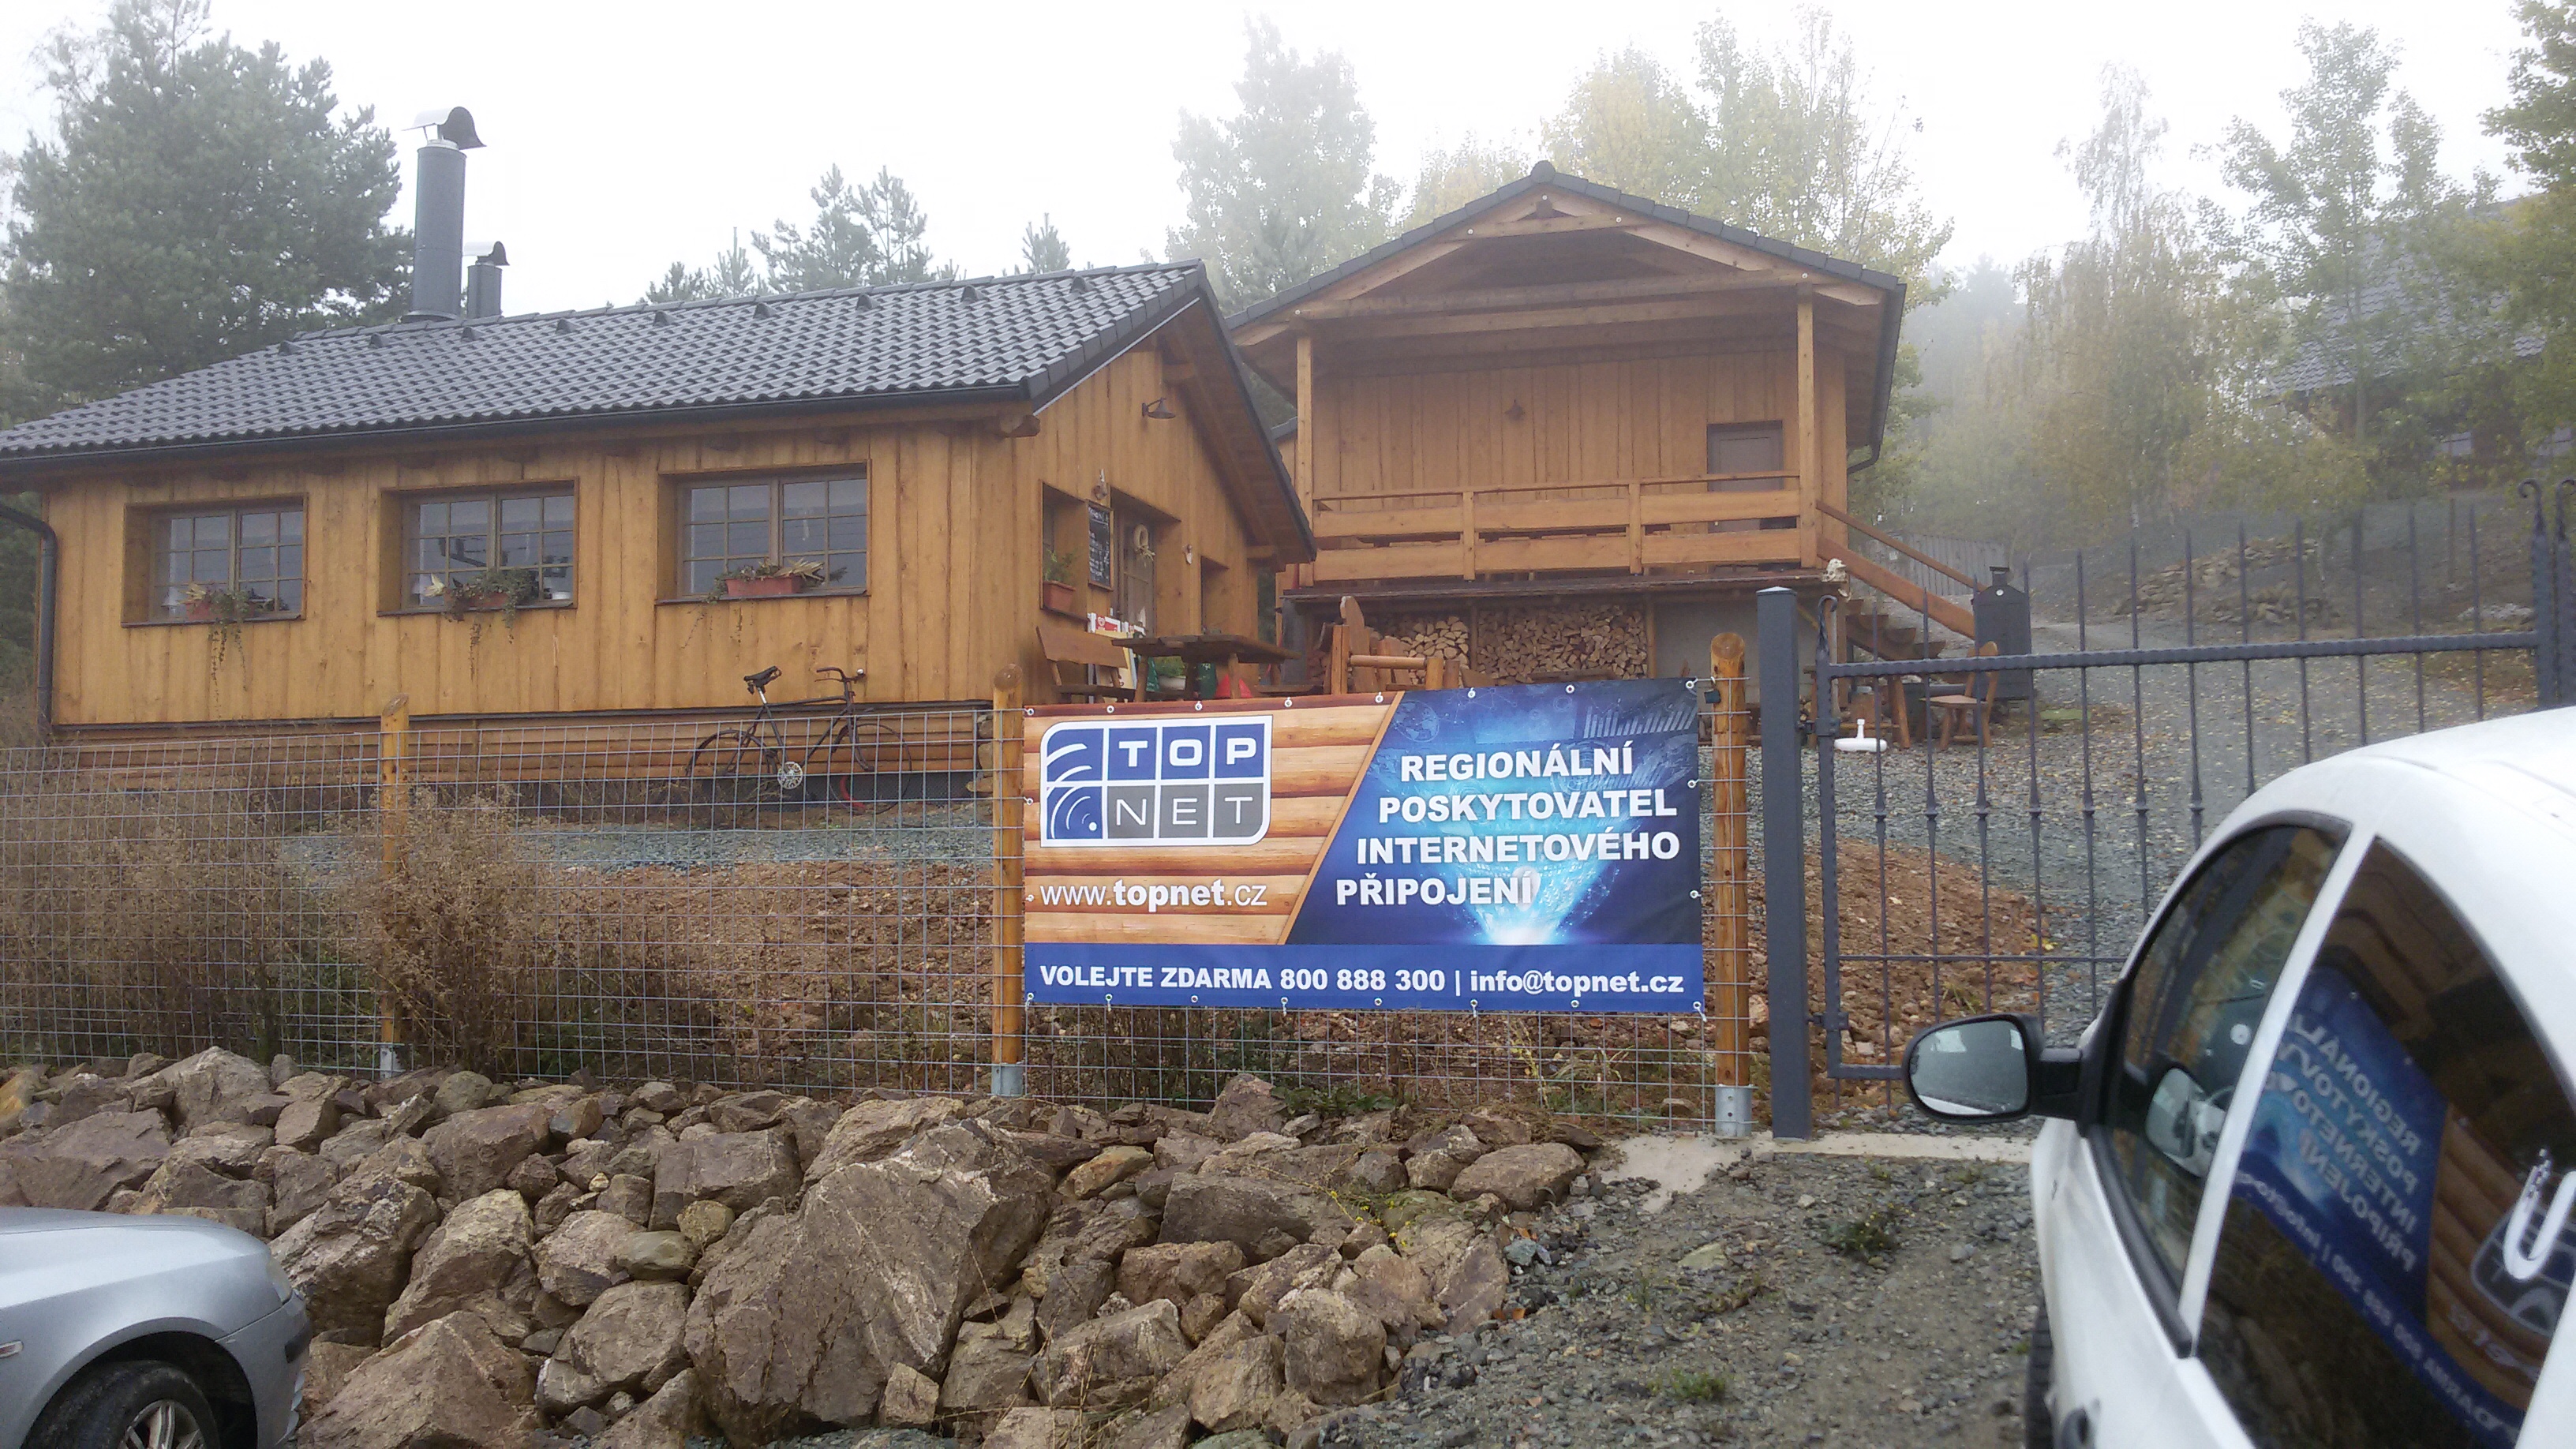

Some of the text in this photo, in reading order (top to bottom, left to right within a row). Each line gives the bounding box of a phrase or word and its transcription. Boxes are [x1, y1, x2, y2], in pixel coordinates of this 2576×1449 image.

[1118, 737, 1257, 767] TOP
[1400, 740, 1634, 782] REGIONÁLNÍ
[1115, 796, 1253, 826] NET
[1379, 788, 1678, 823] POSKYTOVATEL
[1357, 826, 1680, 865] INTERNETOVÉHO
[1039, 878, 1267, 912] www.topnet.cz
[1336, 872, 1533, 905] PŘIPOJENÍ
[1039, 964, 1154, 987] VOLEJTE
[1160, 967, 1273, 990] ZDARMA
[1279, 968, 1328, 990] 800
[1336, 968, 1387, 992] 888
[1395, 968, 1445, 991] 300
[1470, 969, 1685, 997] info@topnet.cz
